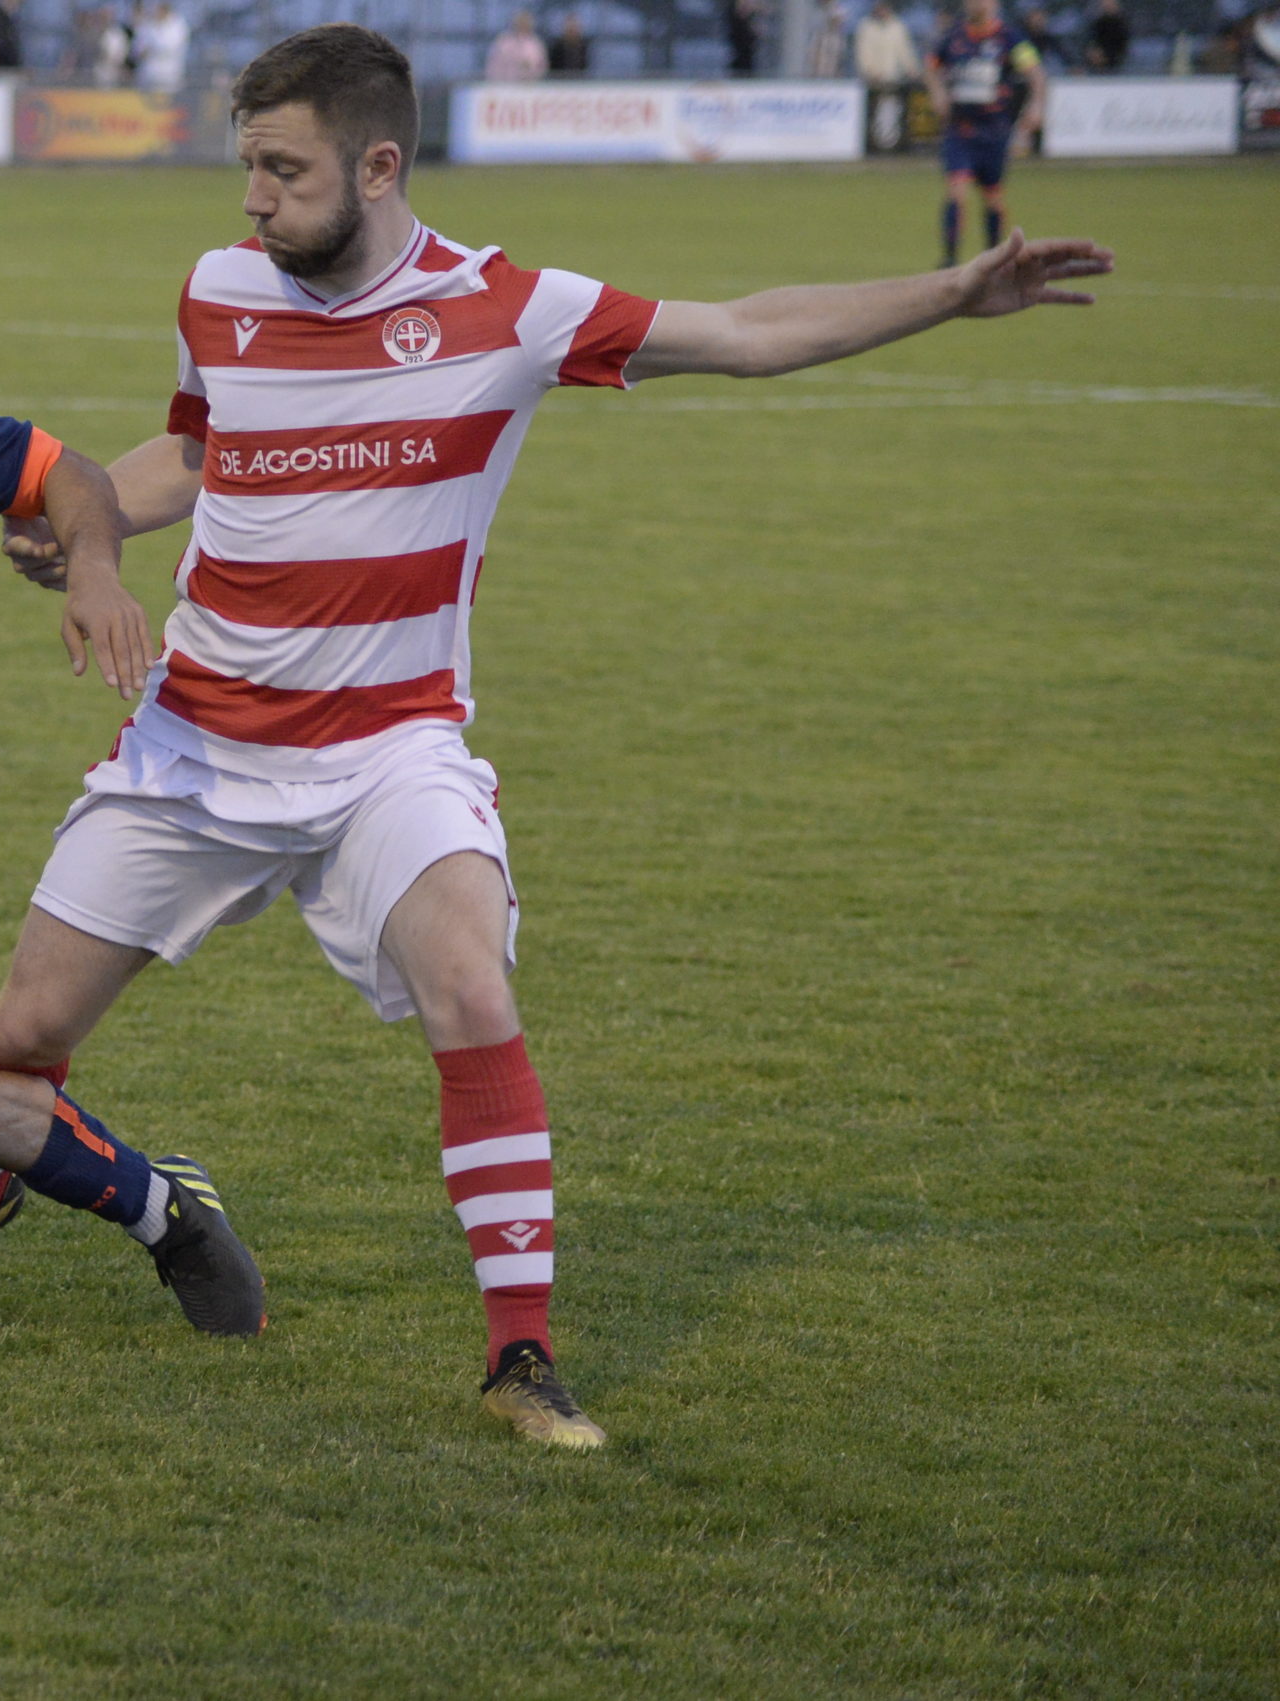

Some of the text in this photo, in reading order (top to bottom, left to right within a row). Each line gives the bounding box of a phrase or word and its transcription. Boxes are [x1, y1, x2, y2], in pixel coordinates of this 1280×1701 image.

[404, 354, 424, 363] 1923
[220, 438, 437, 475] DE AGOSTINI SA
